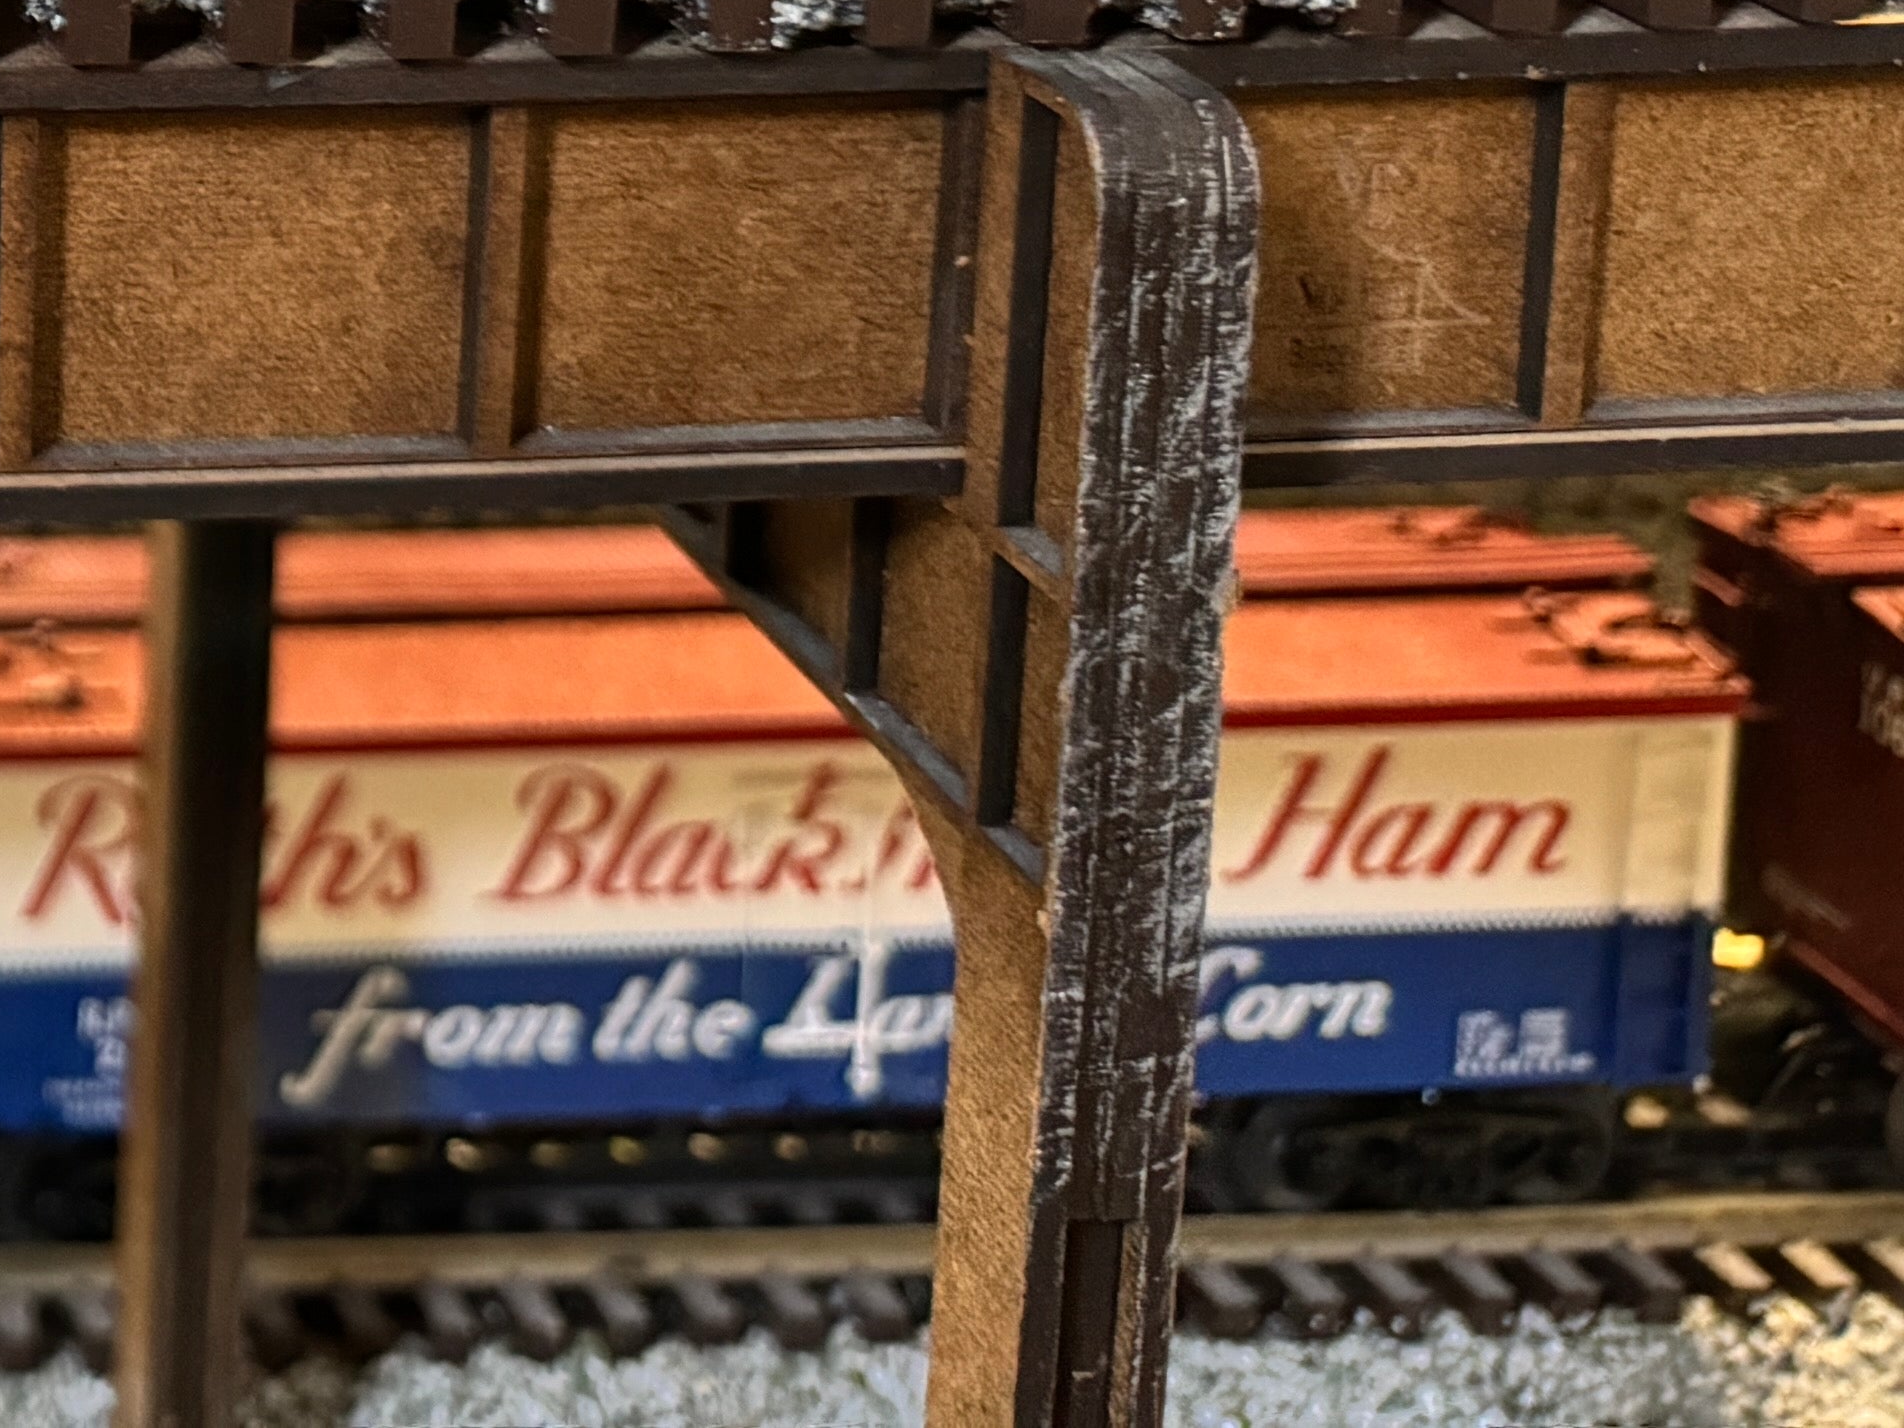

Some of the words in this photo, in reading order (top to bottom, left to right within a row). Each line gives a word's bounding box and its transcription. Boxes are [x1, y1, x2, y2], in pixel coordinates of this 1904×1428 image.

[1220, 742, 1574, 886] Ham
[278, 964, 586, 1108] from
[594, 956, 759, 1064] the
